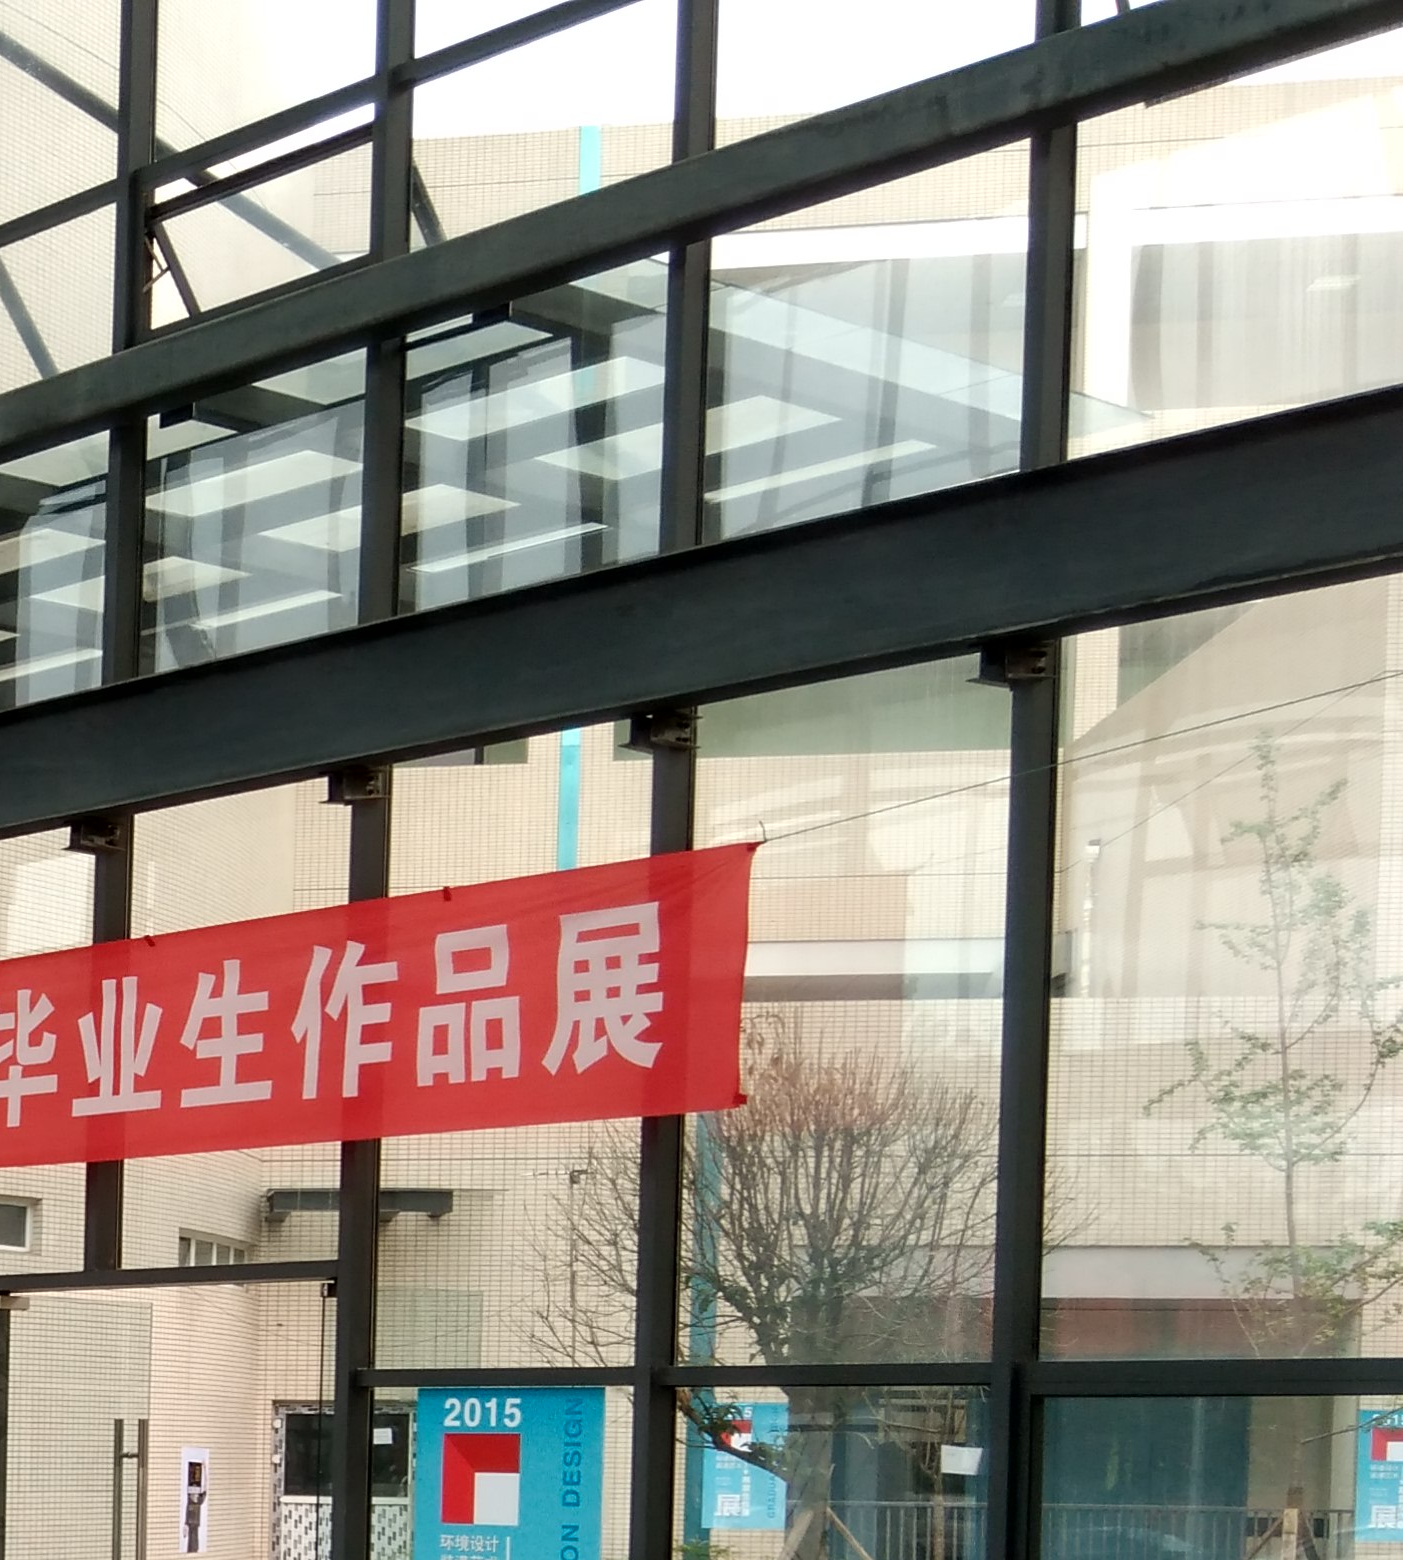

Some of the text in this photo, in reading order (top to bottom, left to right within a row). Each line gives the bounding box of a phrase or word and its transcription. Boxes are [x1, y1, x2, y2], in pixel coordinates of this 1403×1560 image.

[443, 1397, 522, 1428] 2015
[563, 1397, 583, 1508] DESIGN
[439, 1534, 500, 1553] 环境设计
